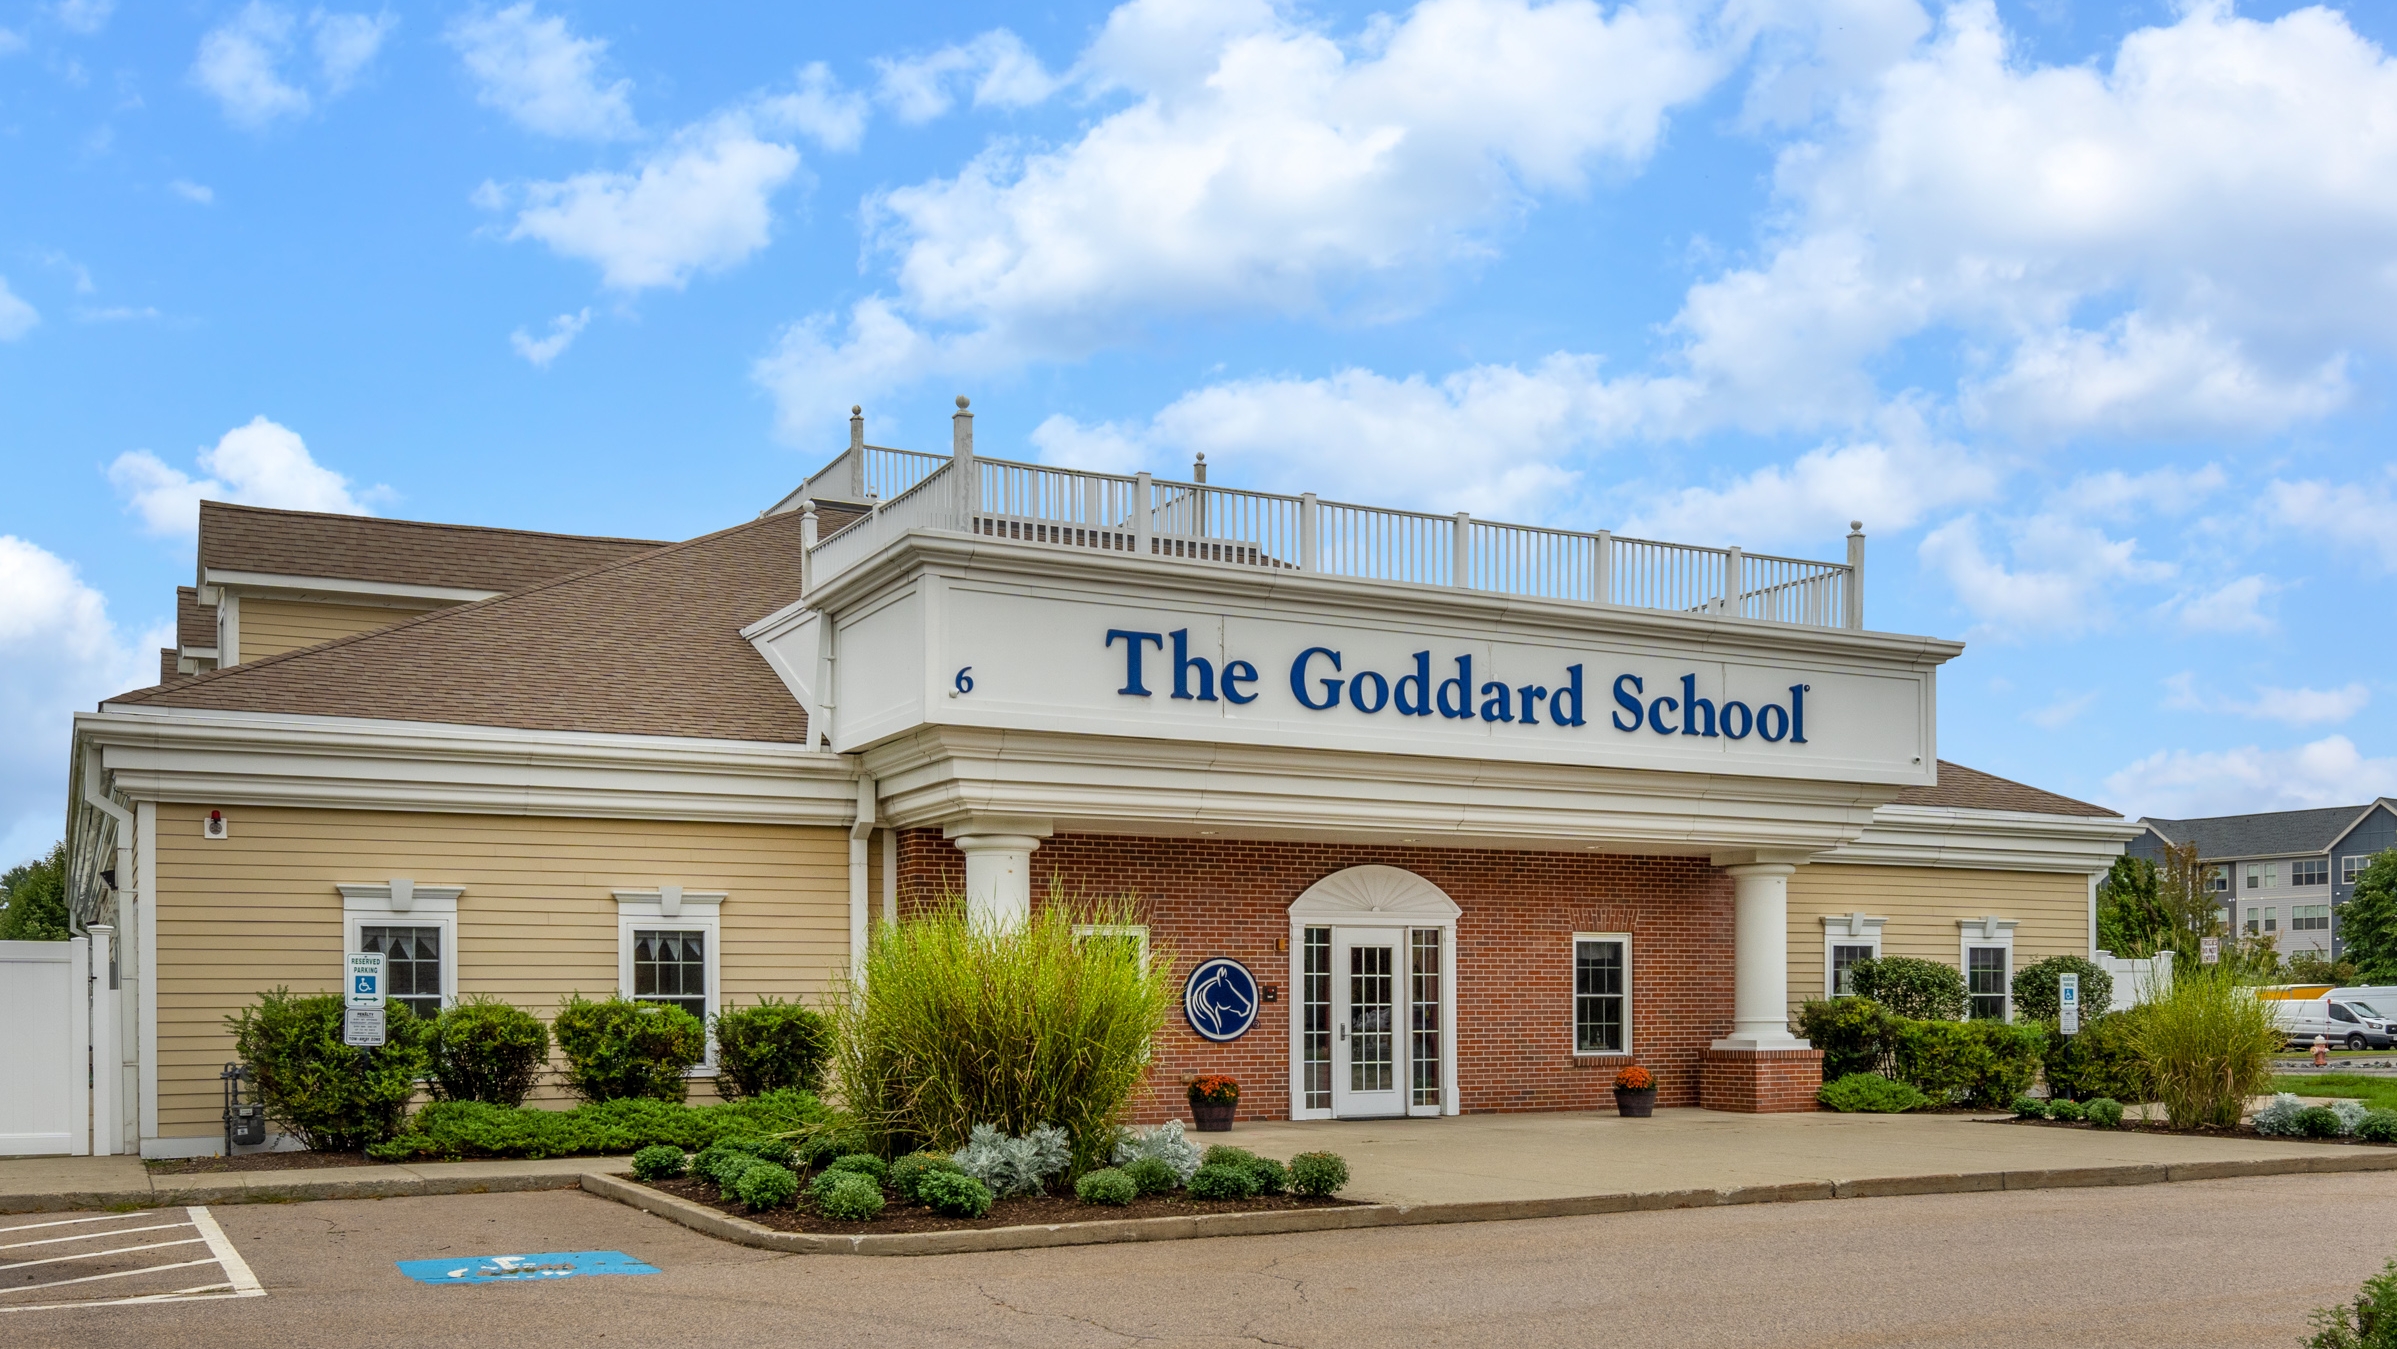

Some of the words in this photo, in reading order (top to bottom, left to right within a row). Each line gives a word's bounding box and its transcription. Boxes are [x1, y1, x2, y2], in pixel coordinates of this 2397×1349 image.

[955, 666, 974, 694] 6
[1105, 627, 1259, 705] The
[1289, 646, 1586, 728] Goddard
[1611, 672, 1806, 745] School
